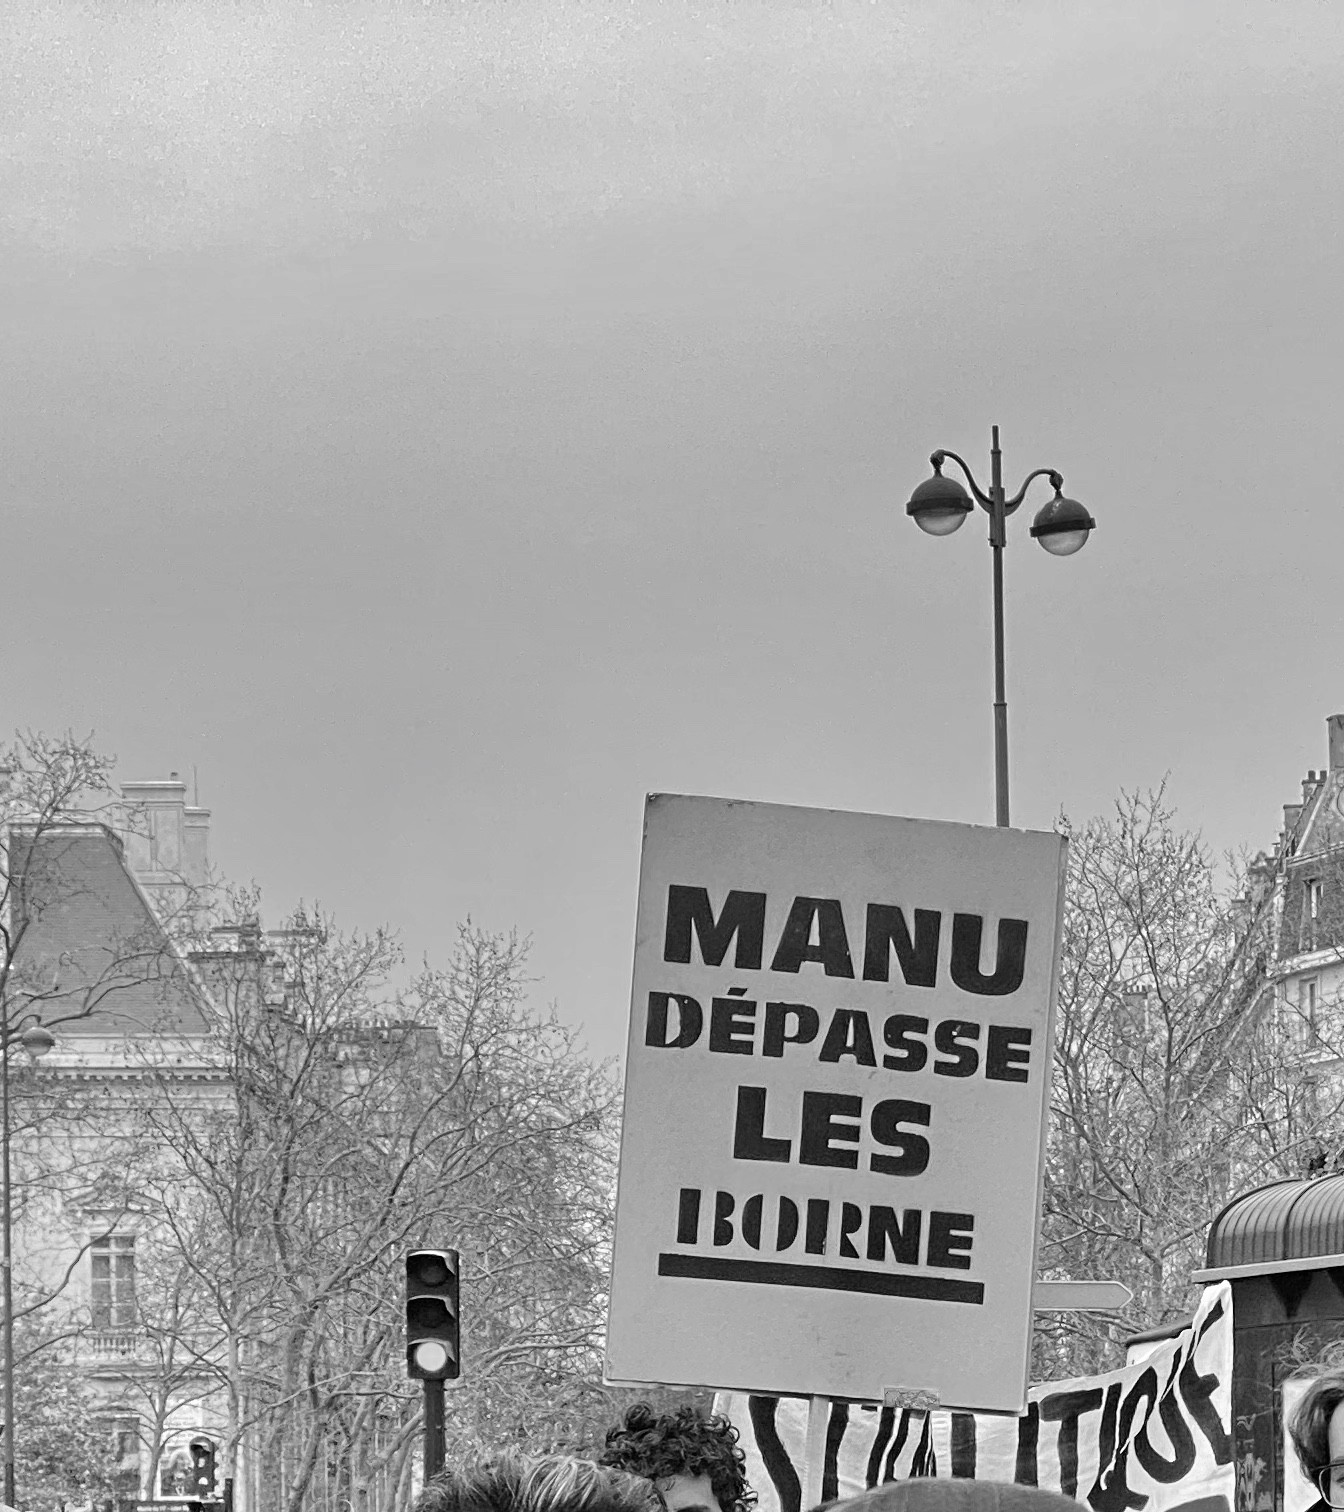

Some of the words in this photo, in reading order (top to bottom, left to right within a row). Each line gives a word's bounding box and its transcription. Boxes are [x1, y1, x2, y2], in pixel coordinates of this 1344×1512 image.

[663, 884, 1029, 996] MANU
[645, 987, 1032, 1084] DÉPASSE
[733, 1085, 932, 1177] LES
[676, 1187, 976, 1270] BORNE
